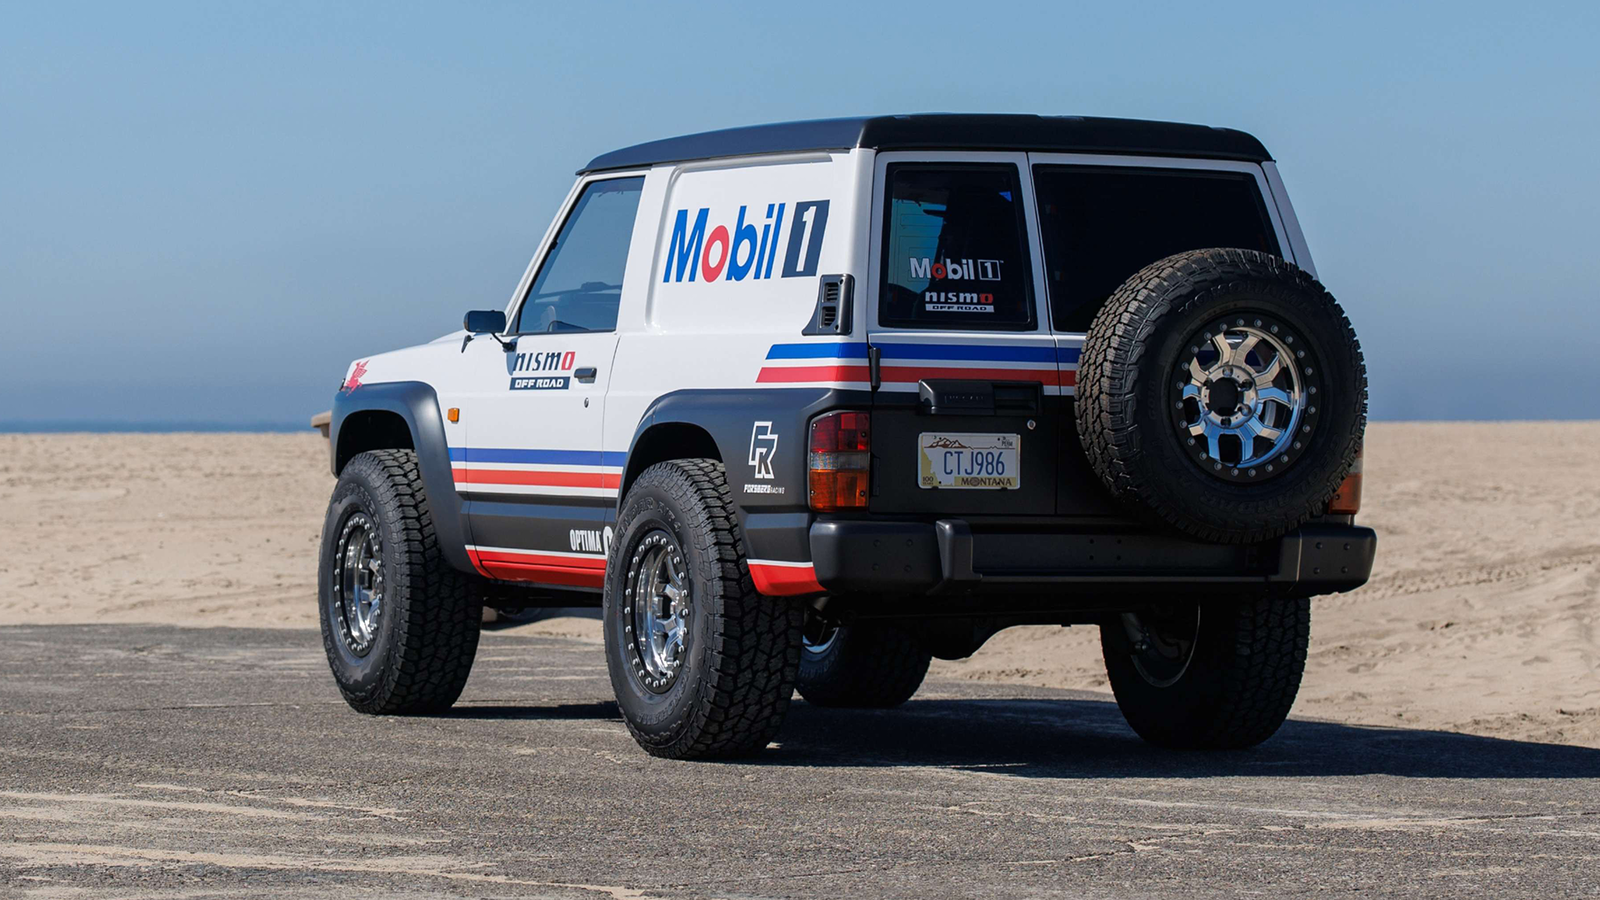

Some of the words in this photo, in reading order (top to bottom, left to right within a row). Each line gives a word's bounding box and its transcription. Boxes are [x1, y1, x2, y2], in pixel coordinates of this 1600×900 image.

[663, 202, 786, 283] Mobil
[909, 257, 975, 280] Mobil
[925, 291, 994, 304] nismo
[512, 350, 576, 372] nismo
[514, 378, 535, 389] OFF
[536, 378, 564, 389] ROAD
[943, 451, 1005, 476] CTJ986
[960, 476, 1012, 487] MONTANA
[569, 528, 602, 552] OPTIMA
